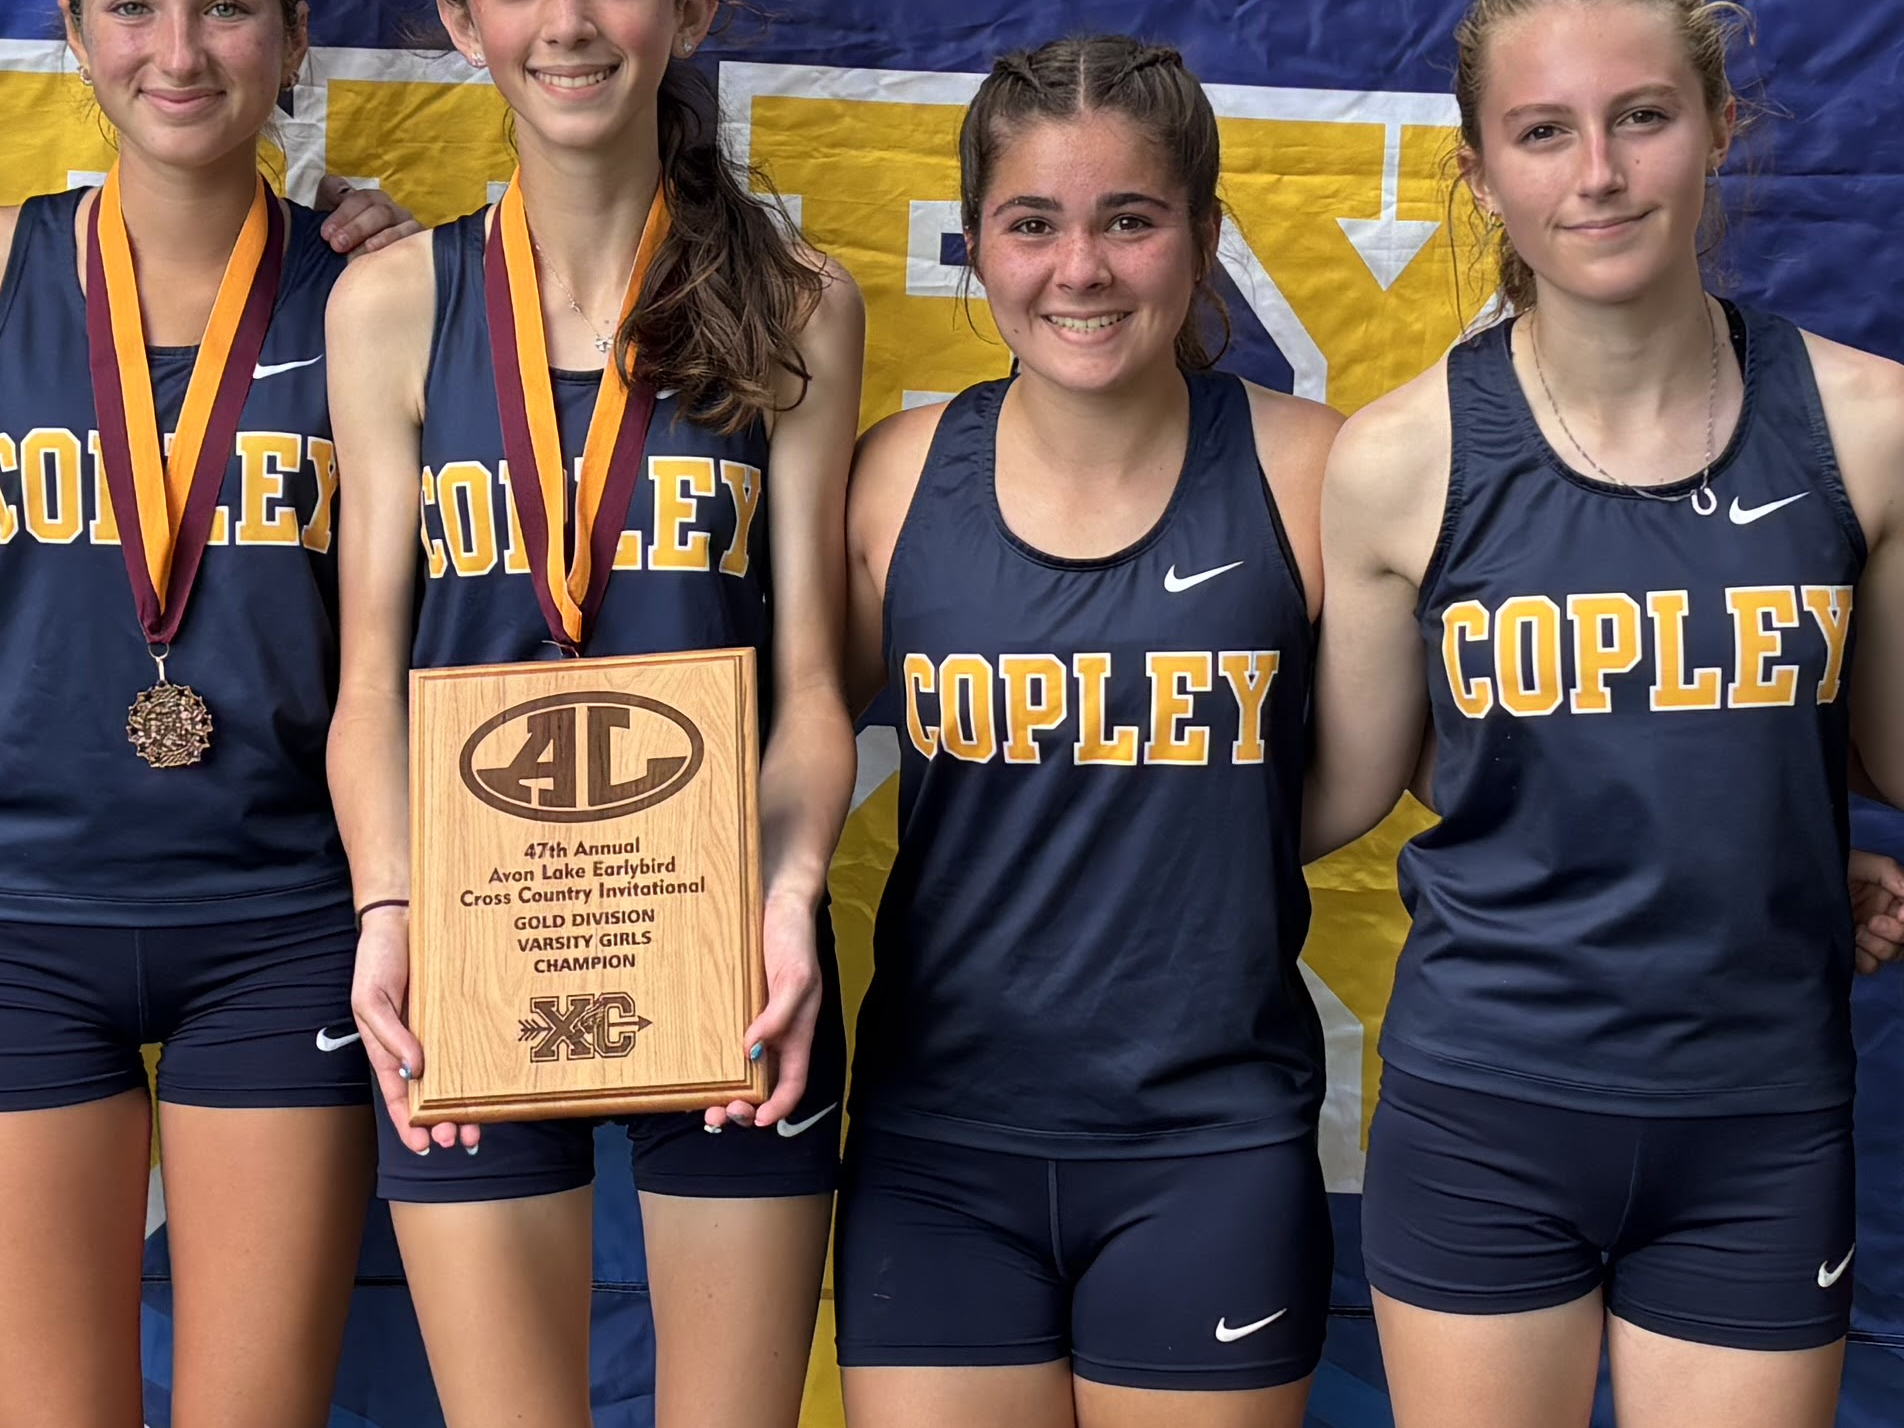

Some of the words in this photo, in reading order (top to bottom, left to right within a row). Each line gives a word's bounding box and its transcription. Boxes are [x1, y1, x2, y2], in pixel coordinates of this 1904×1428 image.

[1442, 584, 1854, 720] COPLEY
[902, 650, 1280, 767] COPLEY
[476, 706, 688, 808] AL
[524, 841, 568, 860] 47th
[574, 836, 640, 857] Annual
[488, 867, 535, 885] Avon
[541, 863, 586, 881] Lake
[592, 855, 676, 880] Earlybird
[460, 889, 511, 907] Cross
[518, 885, 592, 905] Country
[599, 875, 706, 899] Invitational
[514, 913, 566, 931] GOLD
[571, 908, 655, 928] DIVISION
[517, 934, 594, 953] VARSITY
[599, 930, 652, 949] GIRLS
[533, 953, 636, 974] CHAMPION
[529, 991, 637, 1064] XC
